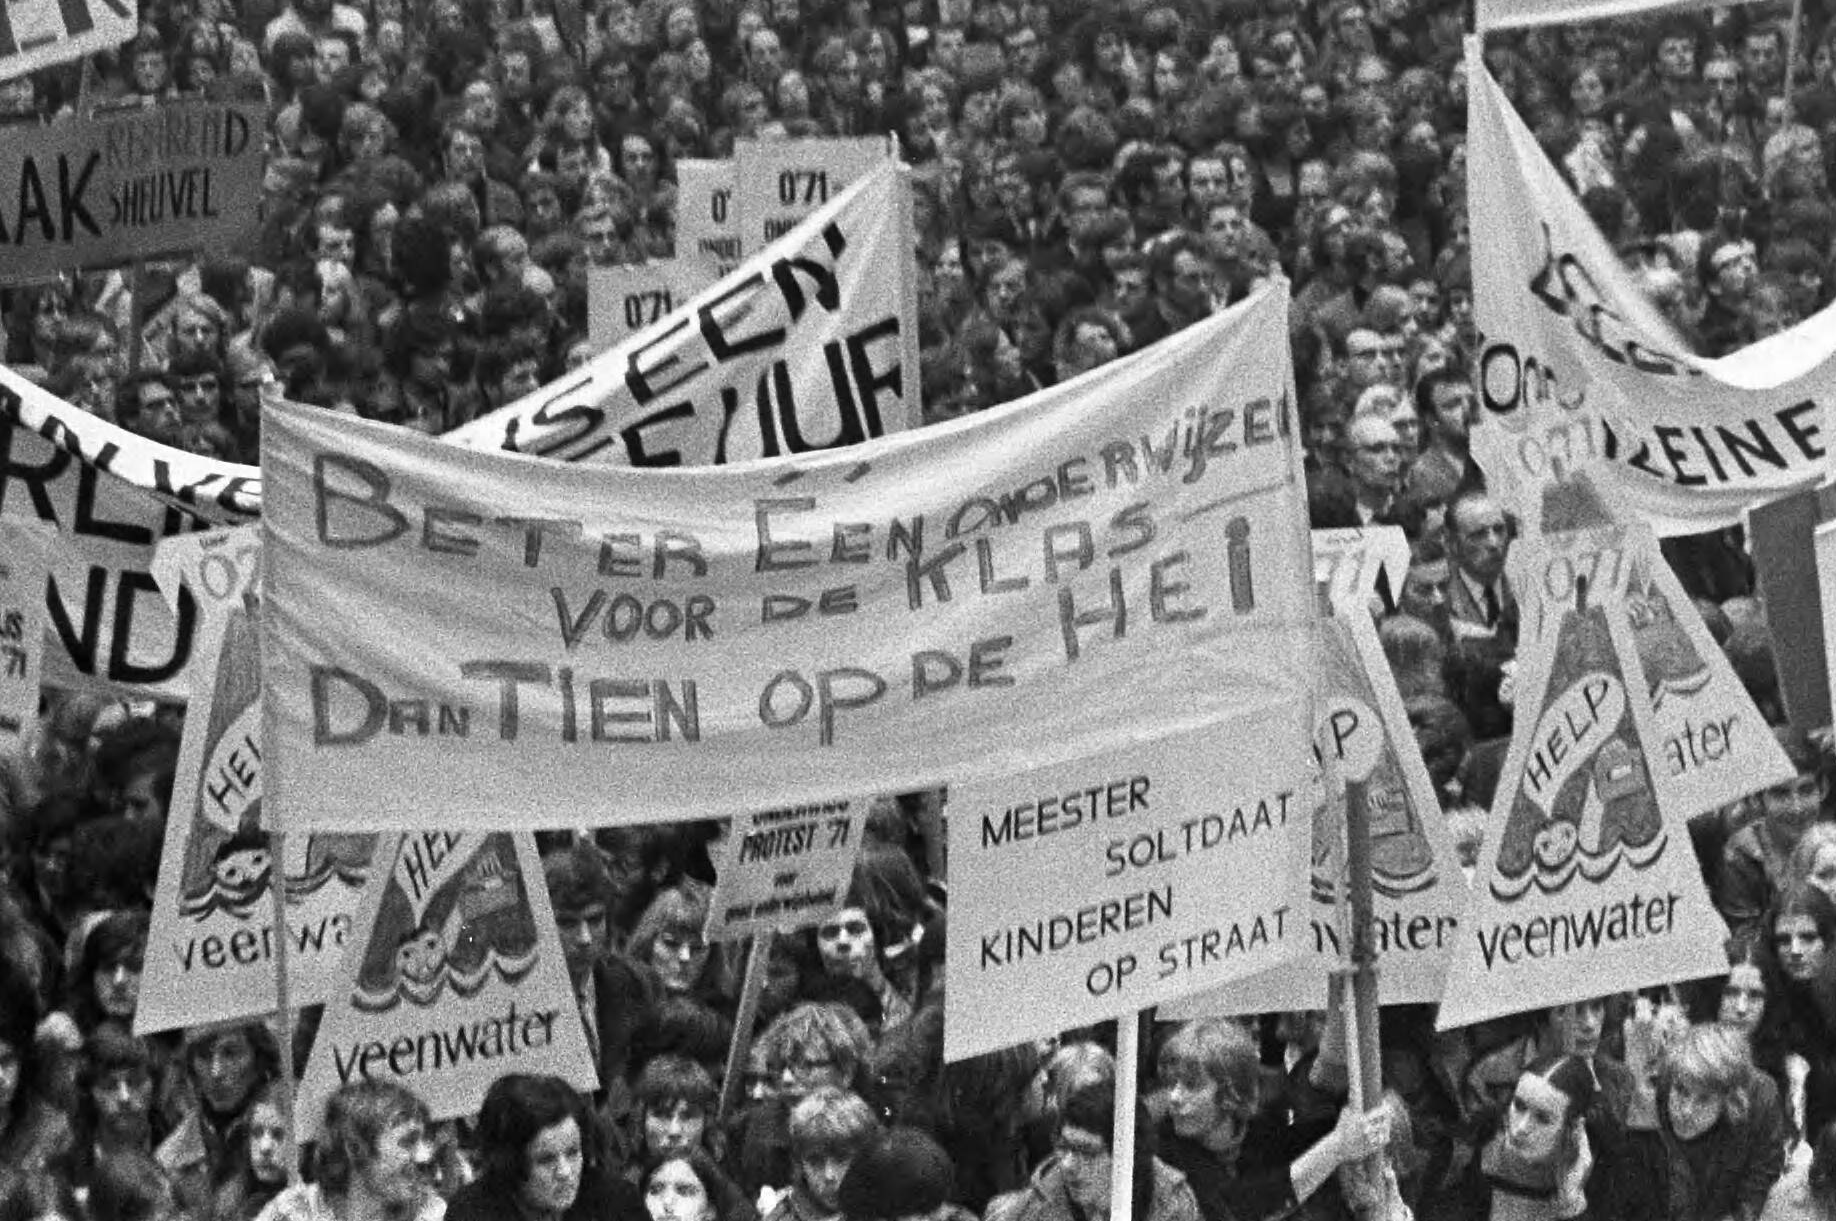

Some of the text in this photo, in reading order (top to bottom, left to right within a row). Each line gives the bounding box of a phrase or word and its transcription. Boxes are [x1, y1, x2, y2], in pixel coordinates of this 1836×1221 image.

[312, 451, 708, 580] BETER
[549, 582, 719, 651] VOOR
[902, 499, 1160, 614] KLAS
[756, 663, 889, 748] OP
[910, 635, 1017, 702] DE
[1525, 678, 1610, 794] HELP
[981, 775, 1151, 850] MEESTER
[1105, 790, 1294, 878] SOLTDAAT
[980, 884, 1173, 971] KINDEREN
[1085, 905, 1291, 997] OP STRAAT
[1477, 889, 1682, 972] veenwater
[331, 1002, 561, 1086] veenwater
